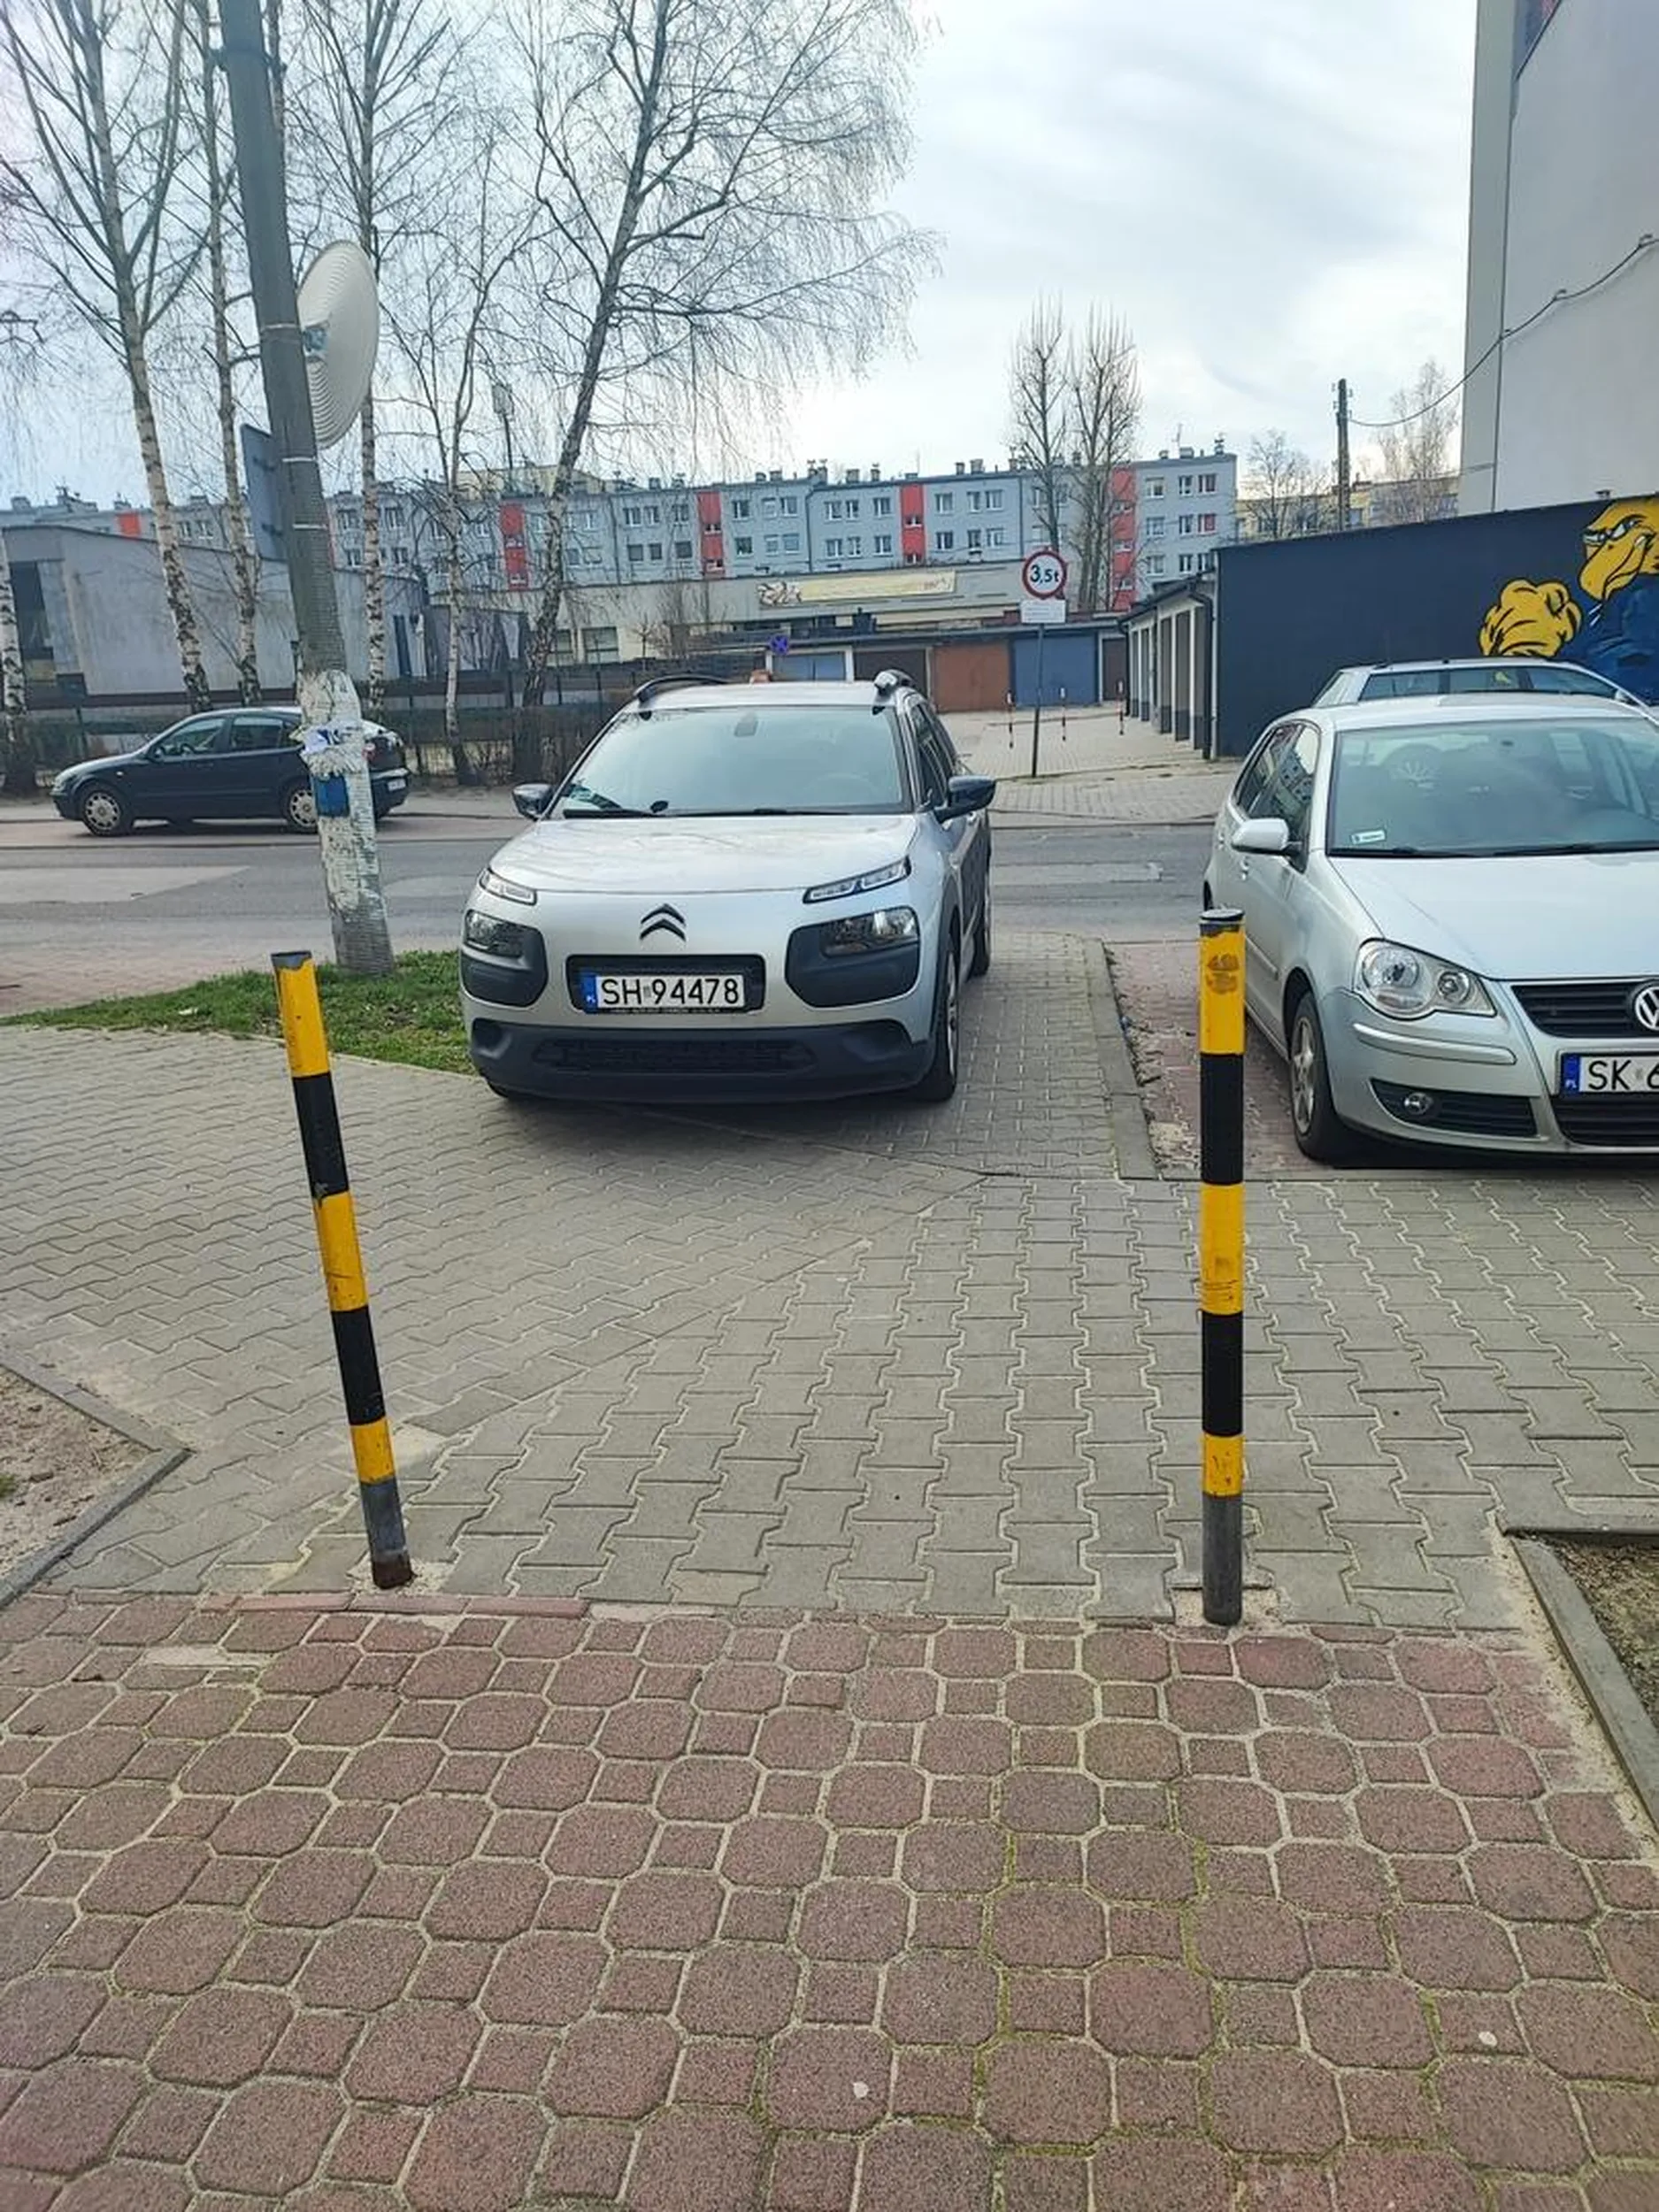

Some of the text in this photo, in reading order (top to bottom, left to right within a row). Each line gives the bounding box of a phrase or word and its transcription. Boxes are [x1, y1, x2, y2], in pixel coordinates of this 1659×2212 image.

[600, 979, 739, 1005] SH 94478
[1588, 1060, 1632, 1091] SK
